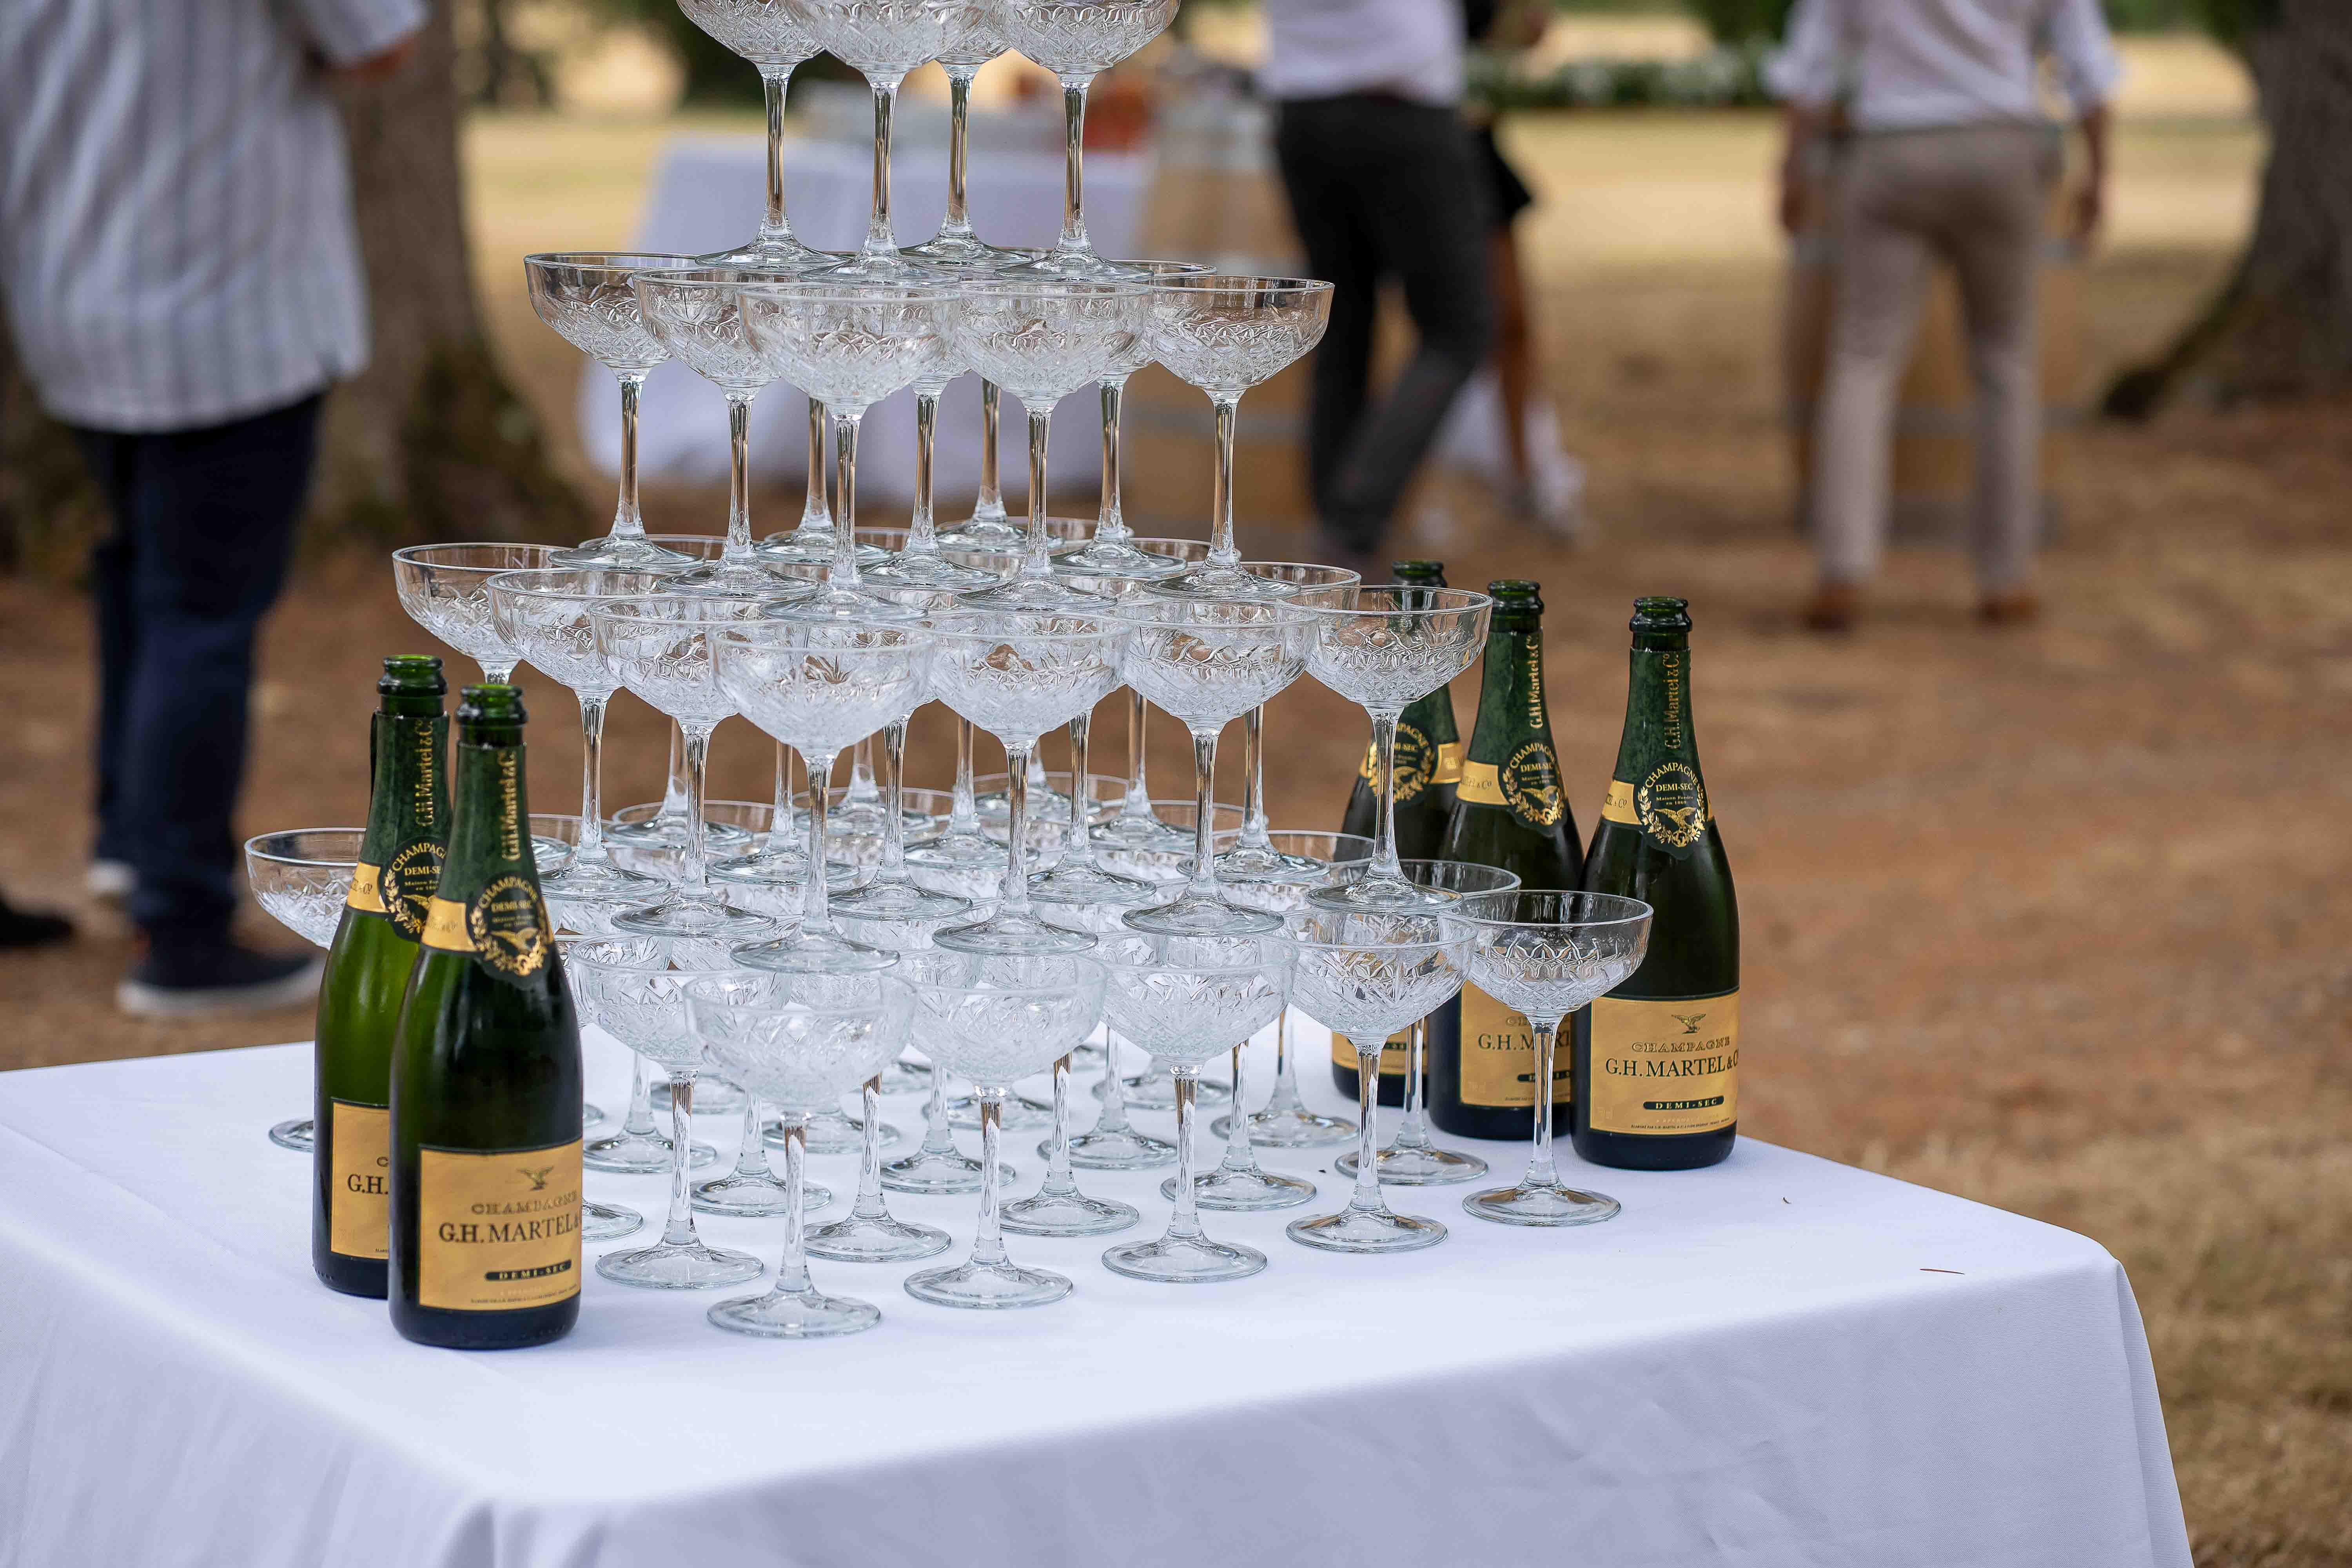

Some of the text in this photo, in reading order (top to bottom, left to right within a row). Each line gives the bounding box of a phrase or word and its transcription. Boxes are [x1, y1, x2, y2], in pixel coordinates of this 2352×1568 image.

[1645, 762, 1698, 788] CHAMPAGNE
[1656, 783, 1693, 792] DEMI-SEC
[392, 843, 446, 871] CHAMPAG
[404, 865, 441, 876] DEMI-SE
[1478, 1033, 1517, 1051] G.H.
[1631, 1036, 1730, 1053] CHAMPAGNE
[1605, 1058, 1643, 1077] G.H.
[1646, 1055, 1726, 1077] MARTEL
[1655, 1098, 1717, 1110] DEMI-SEC
[471, 1189, 578, 1215] CHAMPAGNE
[438, 1221, 485, 1243] G.H.
[488, 1213, 574, 1243] MARTEL
